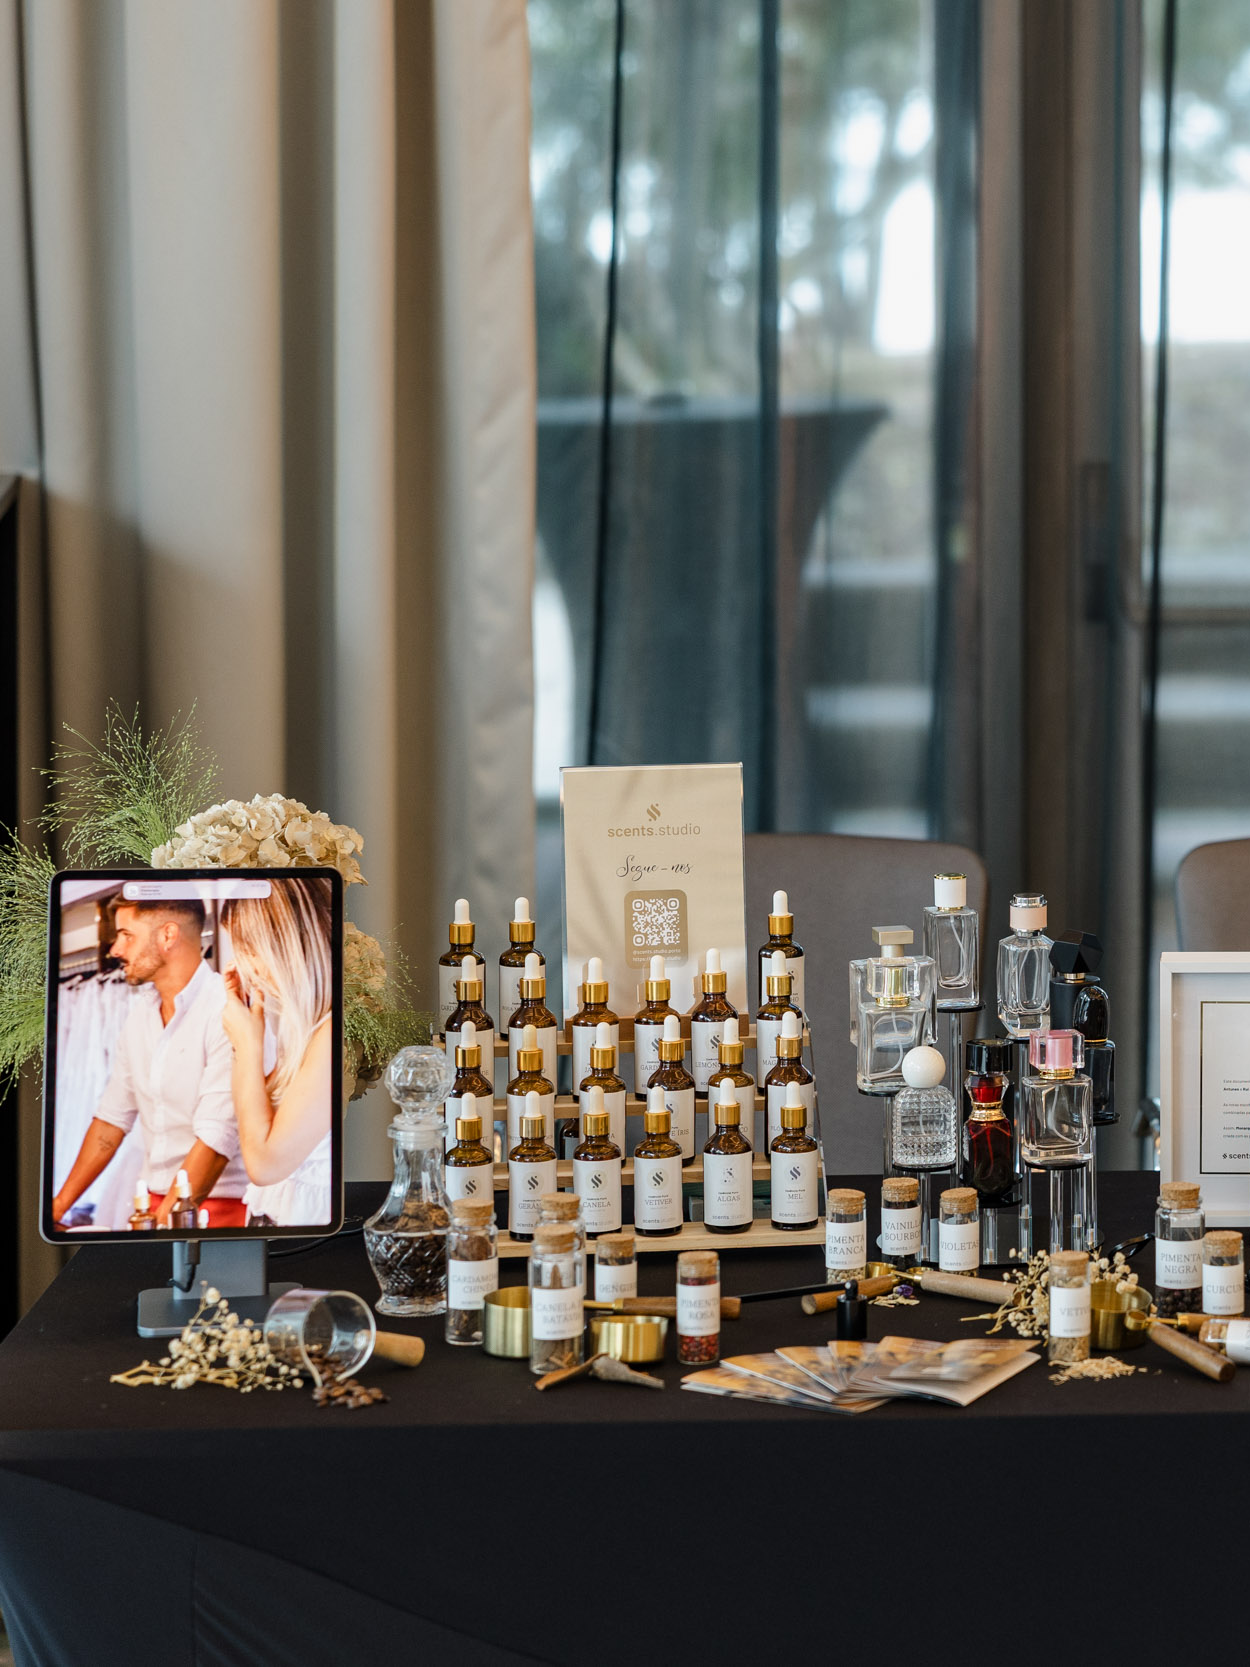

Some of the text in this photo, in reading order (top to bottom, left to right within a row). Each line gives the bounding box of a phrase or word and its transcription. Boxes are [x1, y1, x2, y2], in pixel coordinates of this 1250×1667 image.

[607, 823, 701, 838] scents.studio
[827, 1234, 864, 1243] PIMENTA
[828, 1245, 864, 1256] BRANCA
[940, 1240, 979, 1251] VIOLETAS
[1160, 1252, 1201, 1263] PIMENTA
[1164, 1265, 1198, 1274] NEGRA
